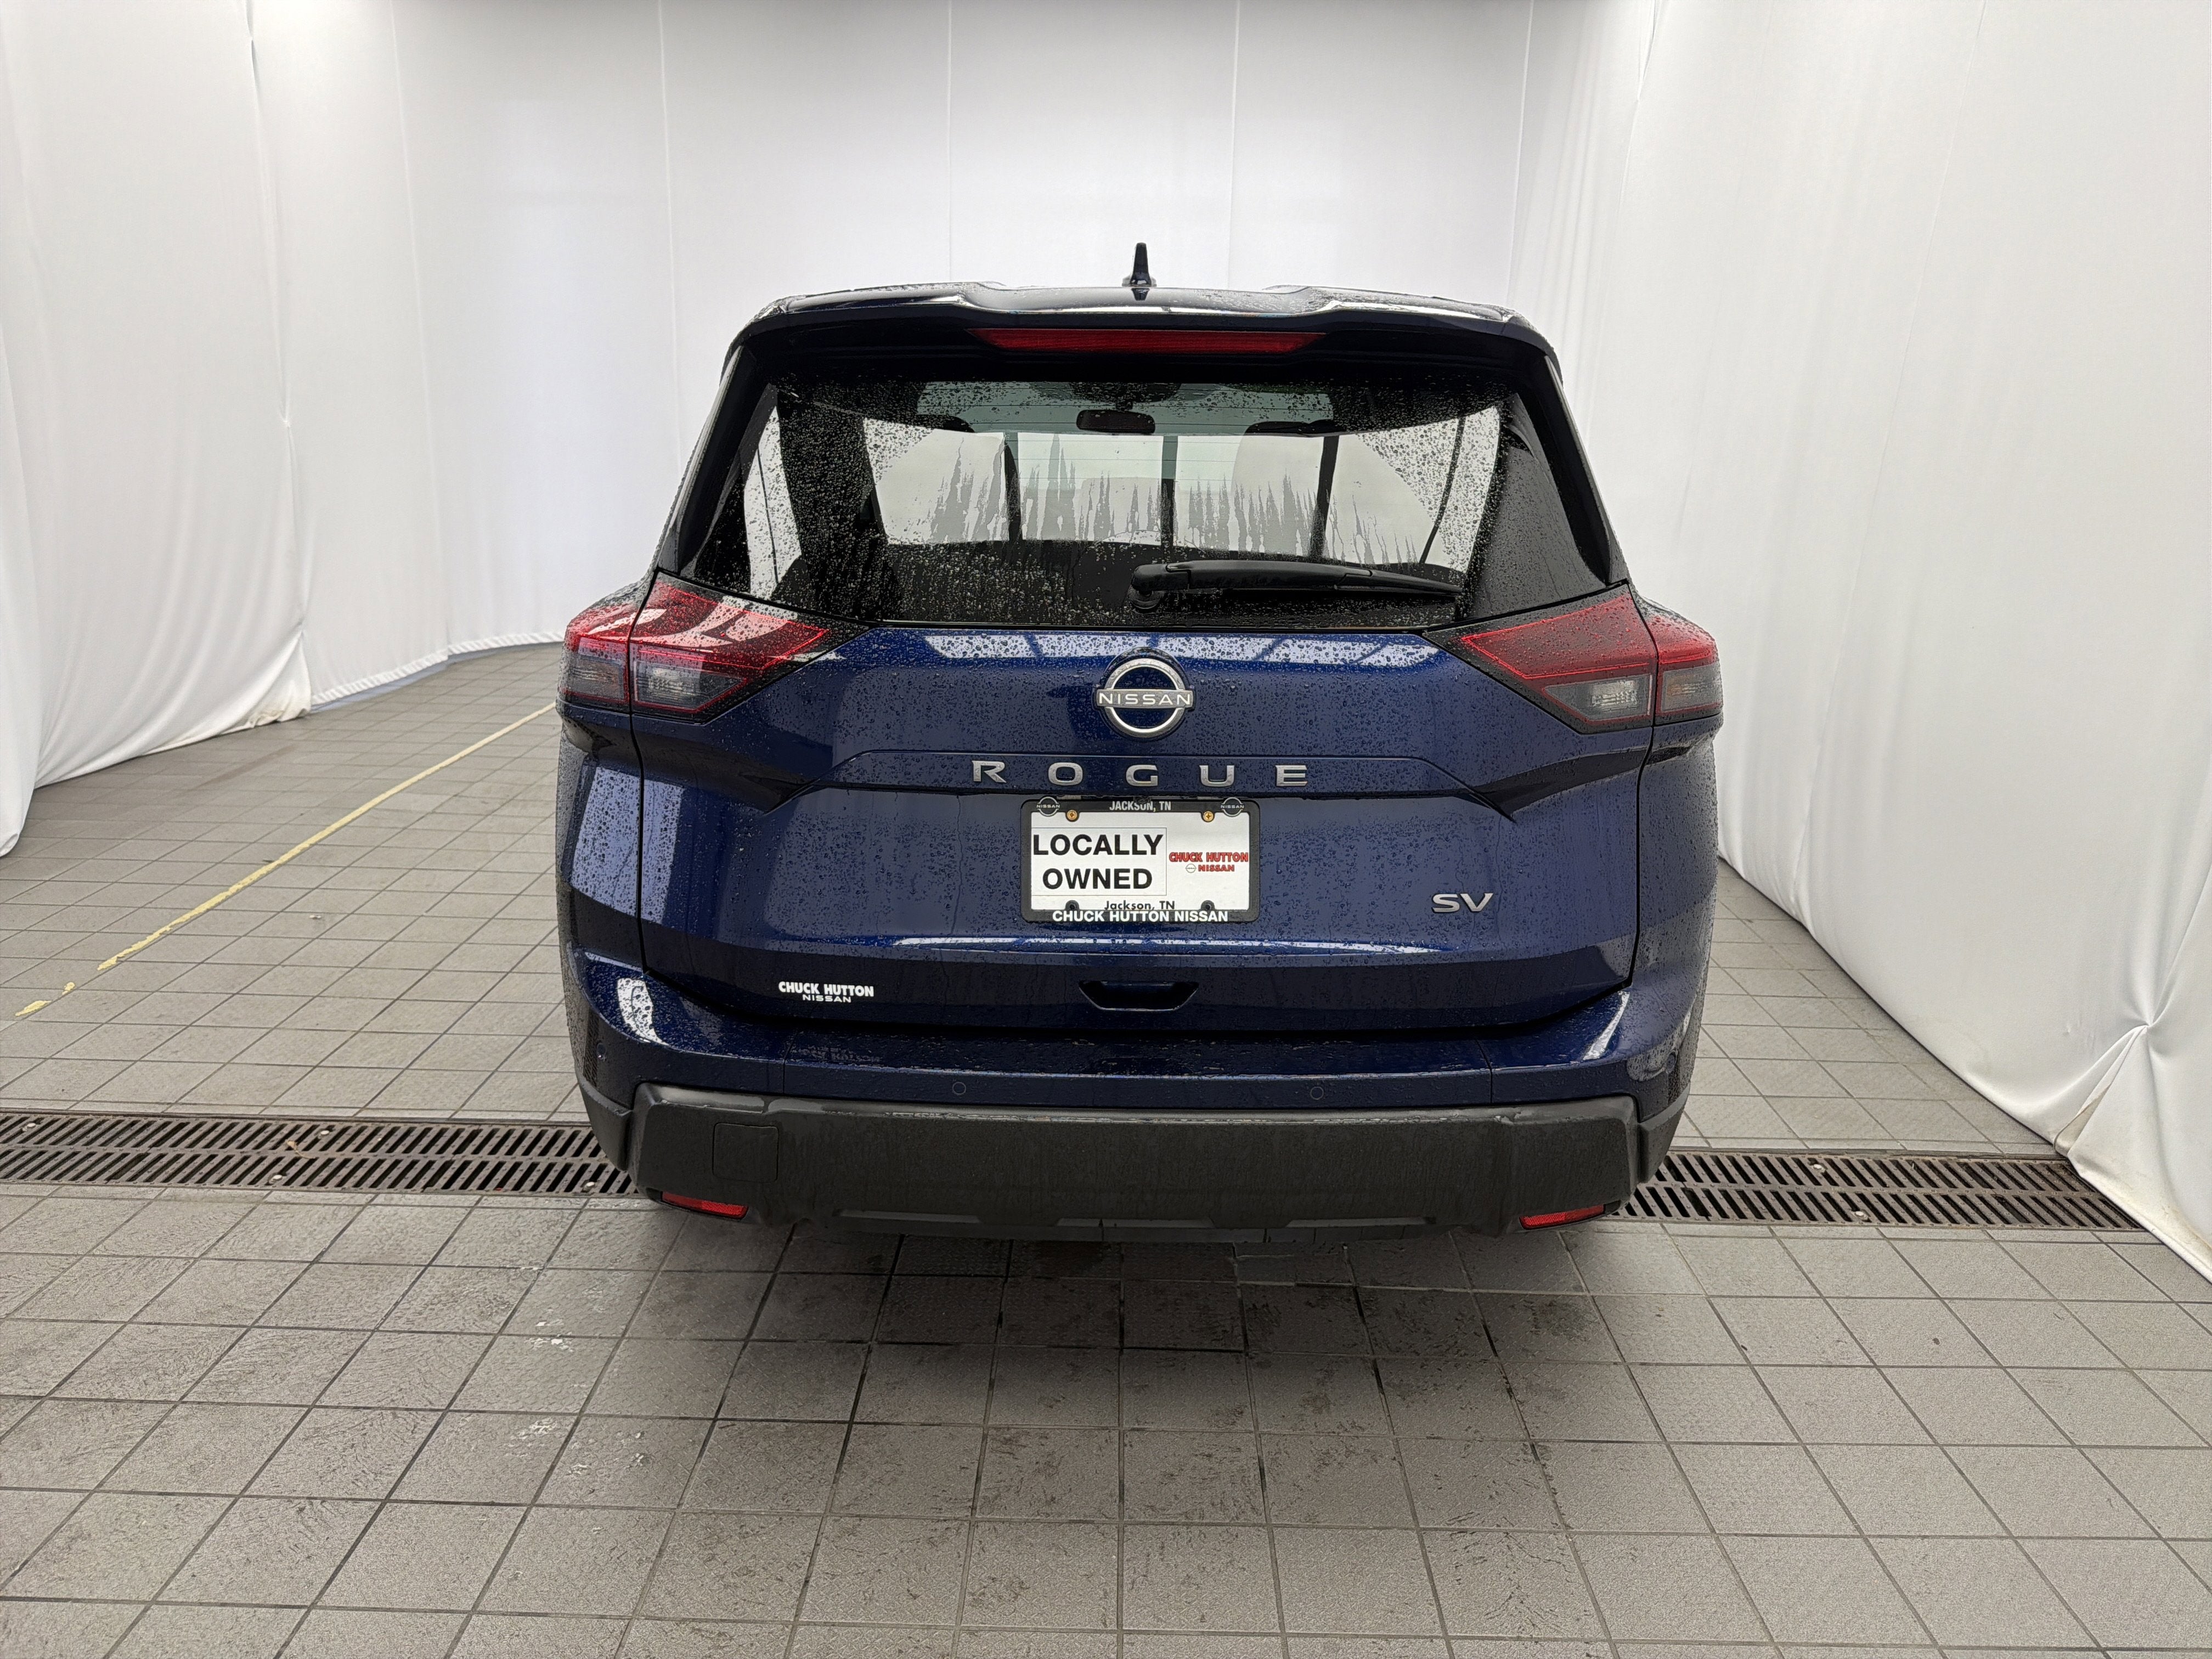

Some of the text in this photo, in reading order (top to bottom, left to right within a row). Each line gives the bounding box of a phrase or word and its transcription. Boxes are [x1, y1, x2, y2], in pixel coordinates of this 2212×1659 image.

[1099, 692, 1190, 706] NISSAN
[972, 760, 1308, 787] ROGUE
[1159, 801, 1171, 811] TN
[1033, 834, 1164, 856] LOCALLY
[1169, 852, 1249, 862] CHUCK HUTTON
[1042, 868, 1153, 889] OWNED
[1104, 900, 1175, 911] Jackson, TN
[1432, 893, 1494, 912] SV
[1052, 910, 1228, 922] CHUCK HUTTON NISSAN
[778, 981, 874, 997] CHUCK HUTTON
[802, 994, 851, 1003] NISSAN
